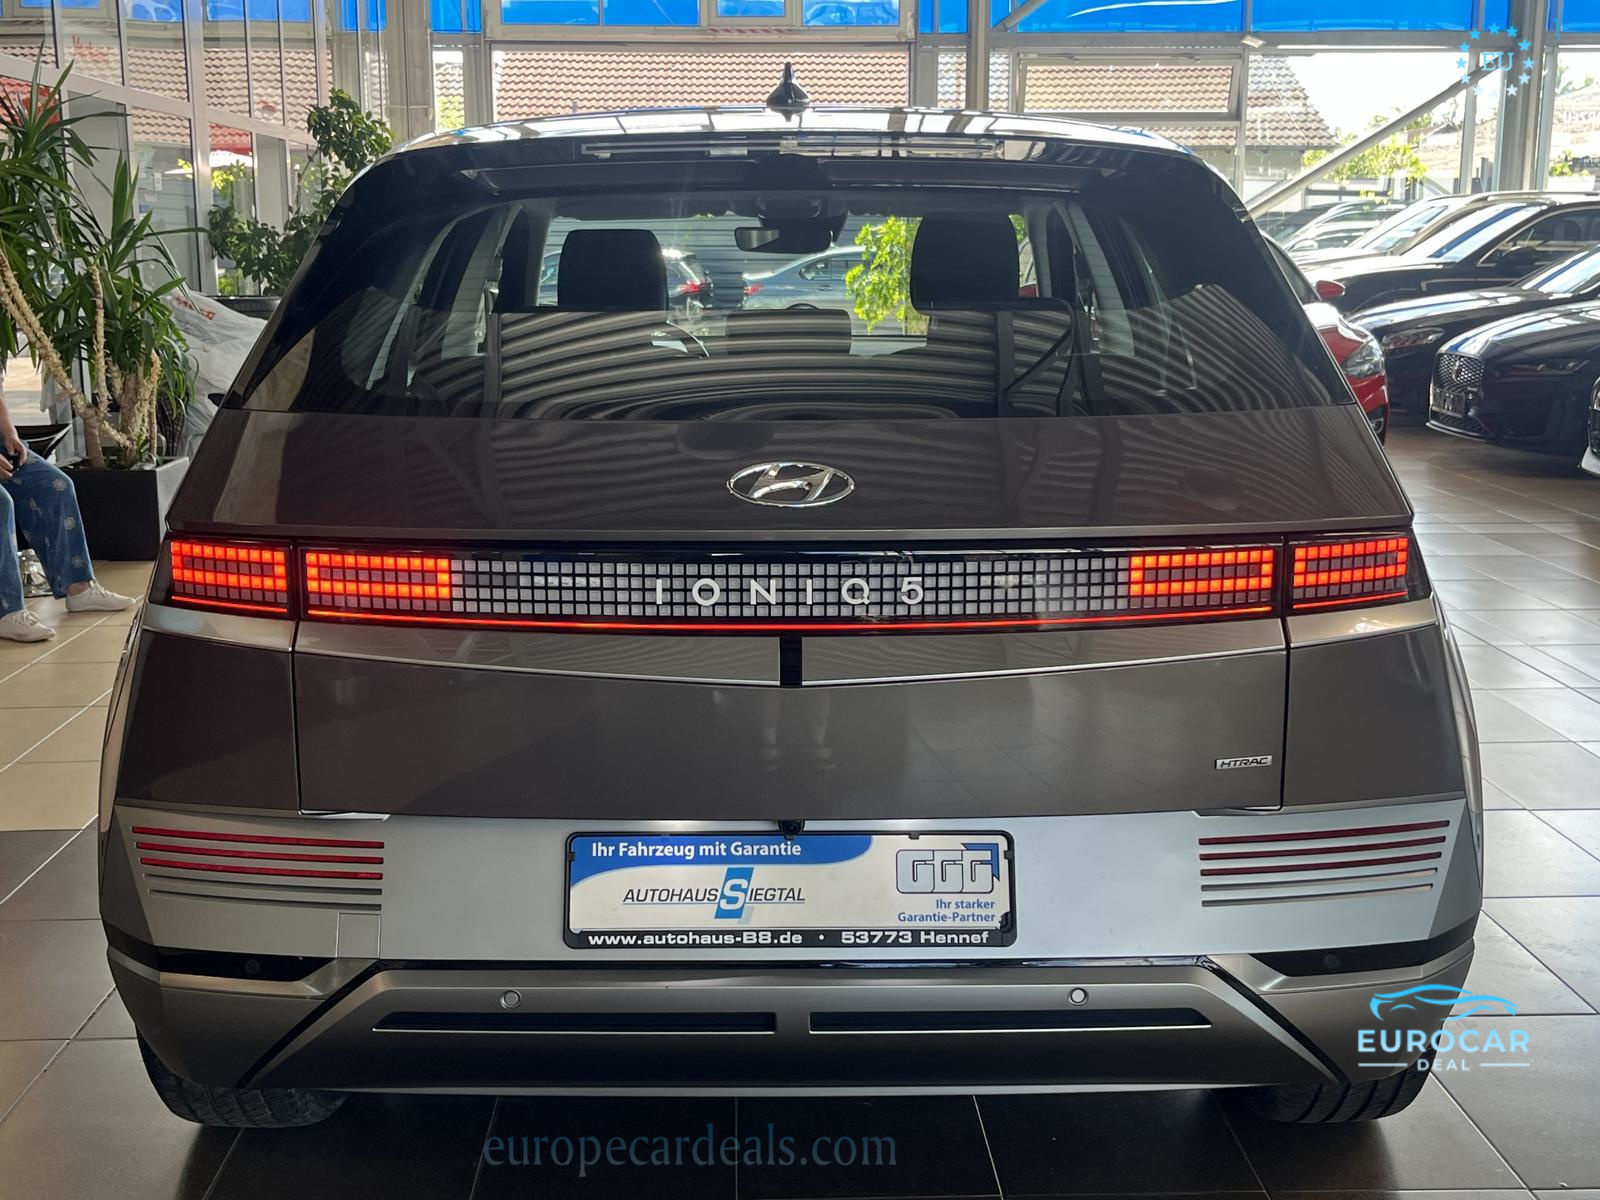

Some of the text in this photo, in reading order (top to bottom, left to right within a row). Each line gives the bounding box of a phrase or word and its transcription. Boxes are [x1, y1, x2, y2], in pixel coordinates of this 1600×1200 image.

[1220, 757, 1269, 768] HTRAC
[592, 842, 802, 859] Ihr Fahrzeug mit Garantie
[623, 878, 806, 910] AUTOHAUS SIEGTAL
[936, 900, 995, 909] Ihr starker
[897, 912, 996, 922] Garantie-Partner
[588, 931, 989, 945] www.autohaus-B8.de 53773 Hennef
